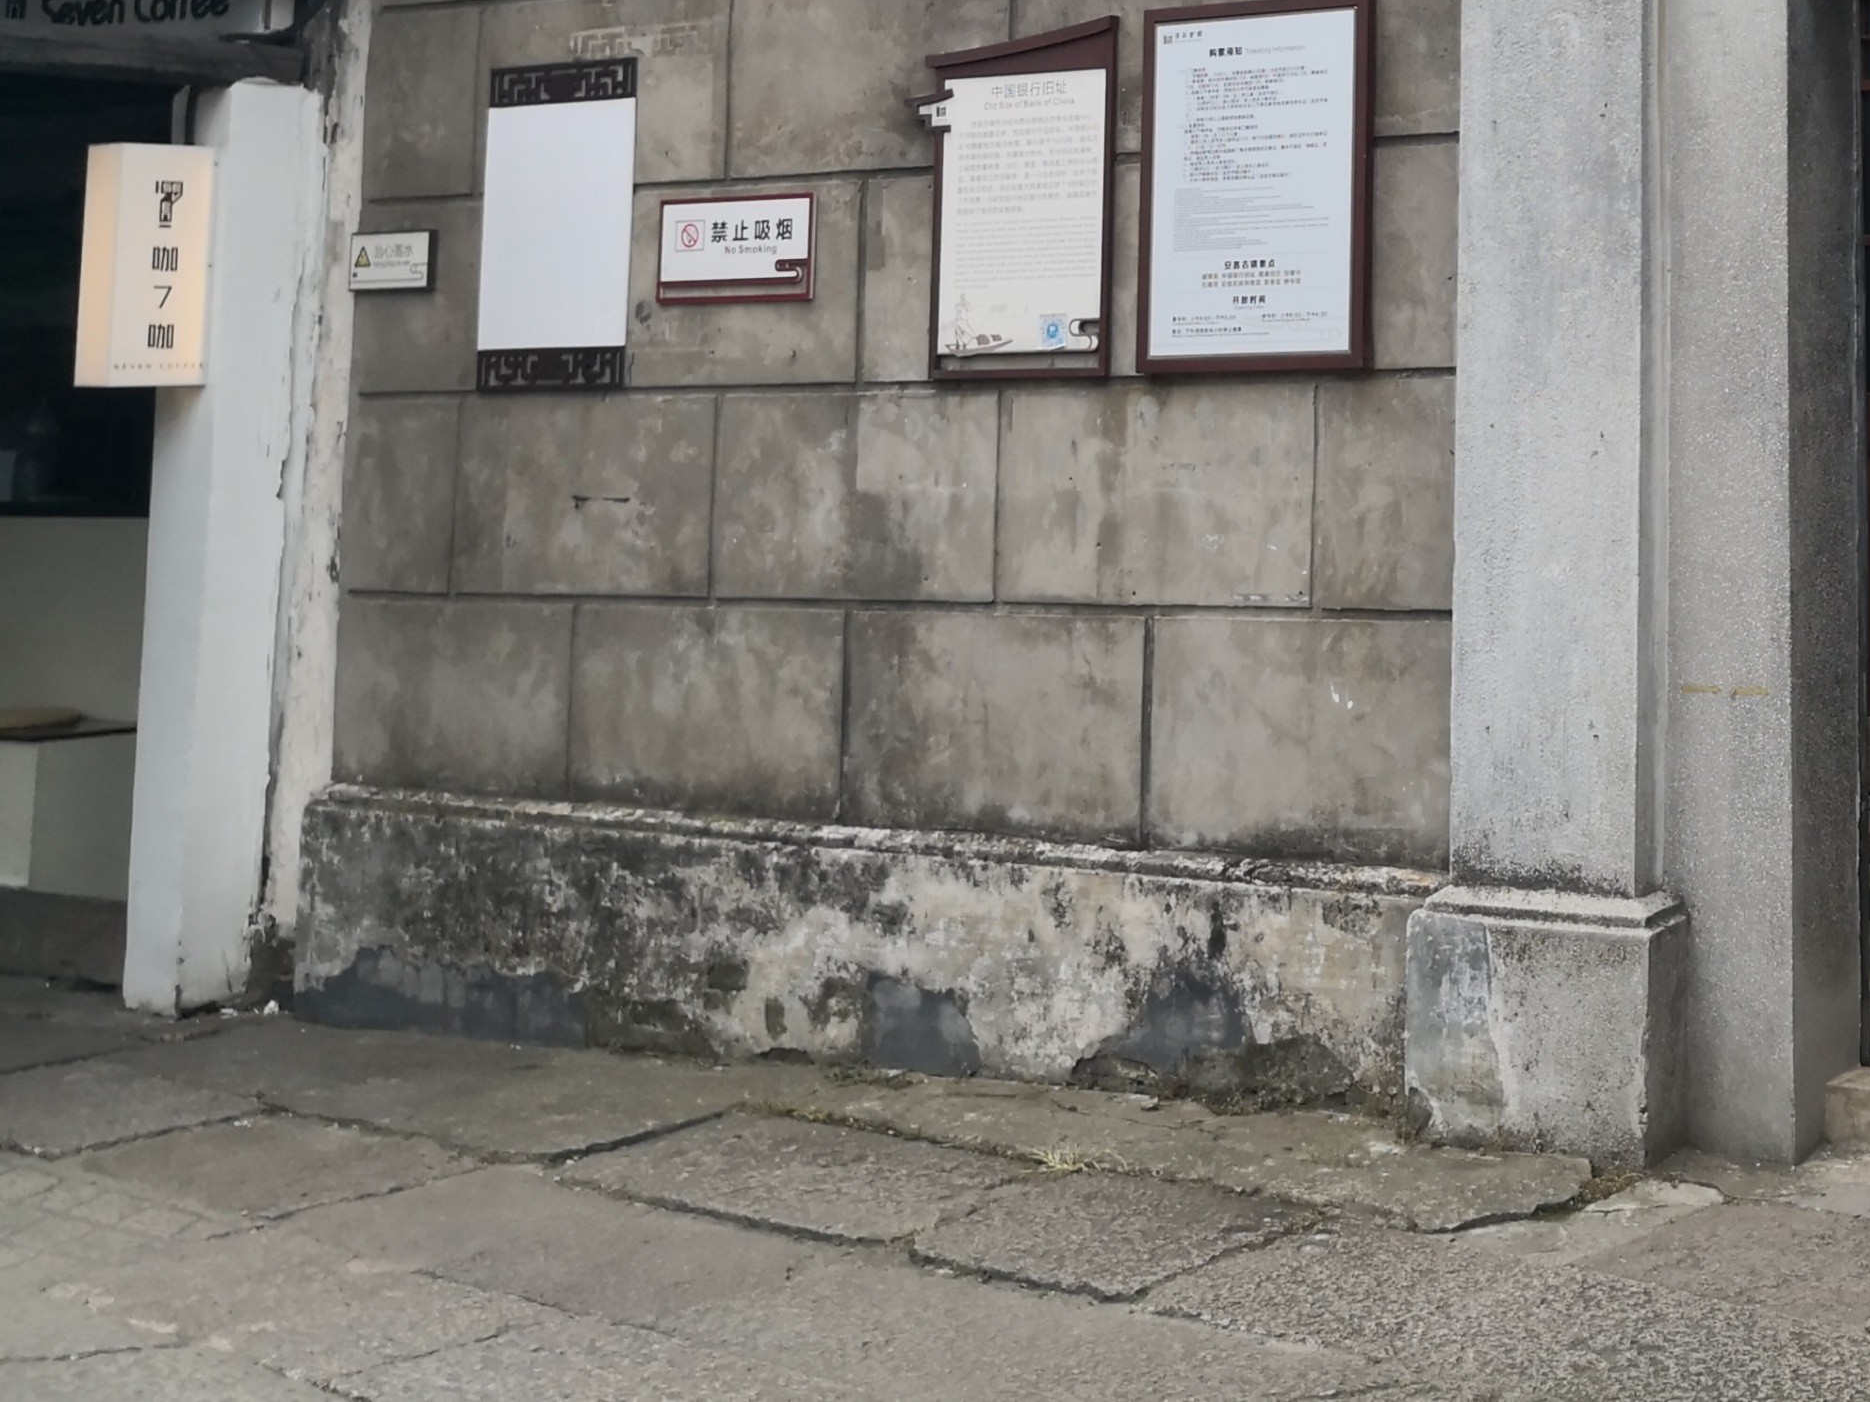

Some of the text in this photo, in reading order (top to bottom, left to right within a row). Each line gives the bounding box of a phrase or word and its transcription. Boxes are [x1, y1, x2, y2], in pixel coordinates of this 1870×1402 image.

[991, 80, 1067, 98] 中国银行旧址
[710, 218, 794, 243] 禁止吸烟
[724, 242, 778, 255] No Smoking
